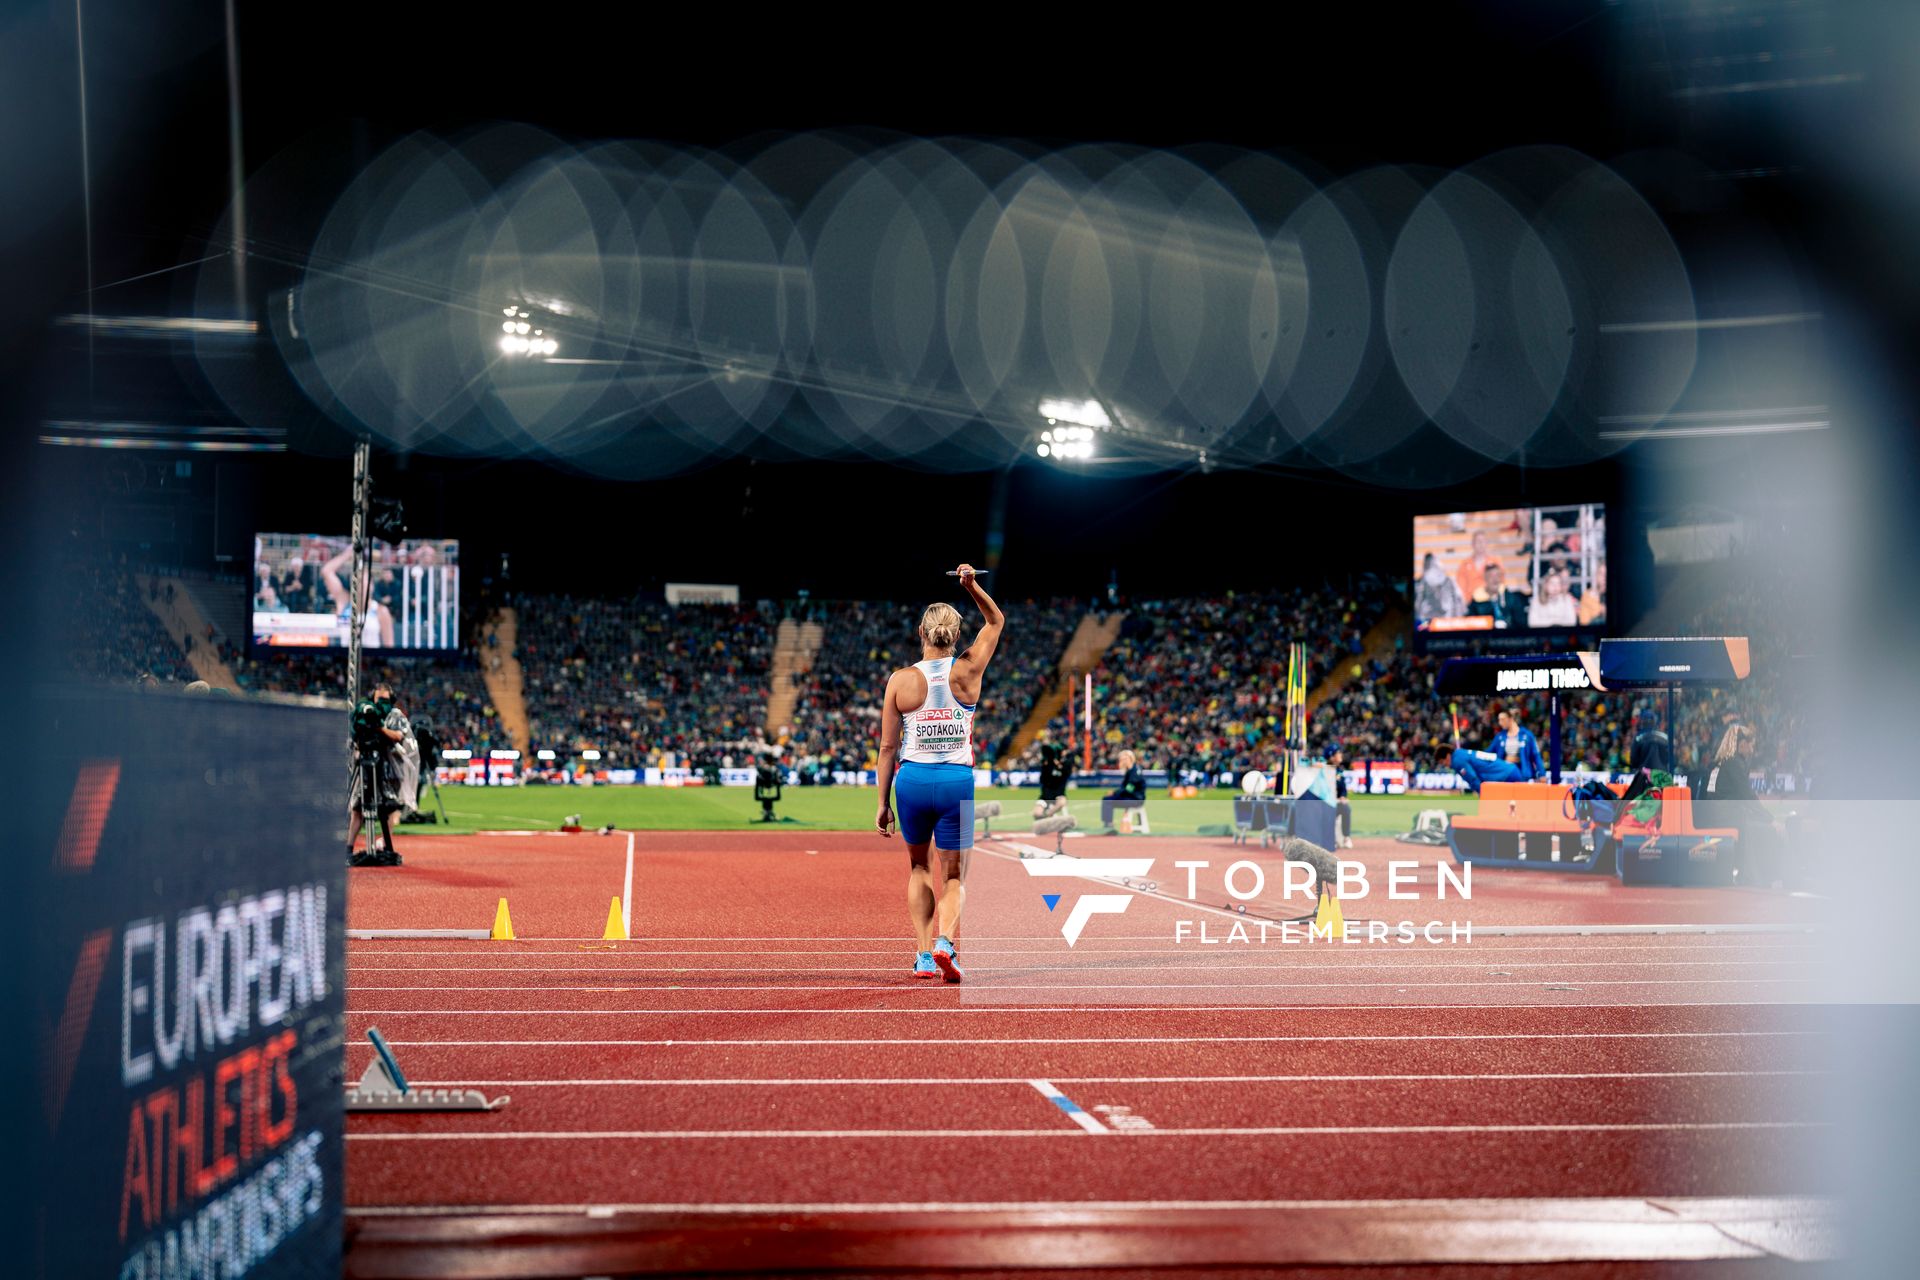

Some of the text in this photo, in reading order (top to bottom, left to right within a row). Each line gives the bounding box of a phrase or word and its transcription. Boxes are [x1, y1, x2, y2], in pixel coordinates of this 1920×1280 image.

[917, 710, 952, 720] SPAR
[916, 723, 965, 737] ŠPOTÁKOVÁ
[947, 742, 964, 750] 2022
[122, 882, 328, 1088] EUROPEAN
